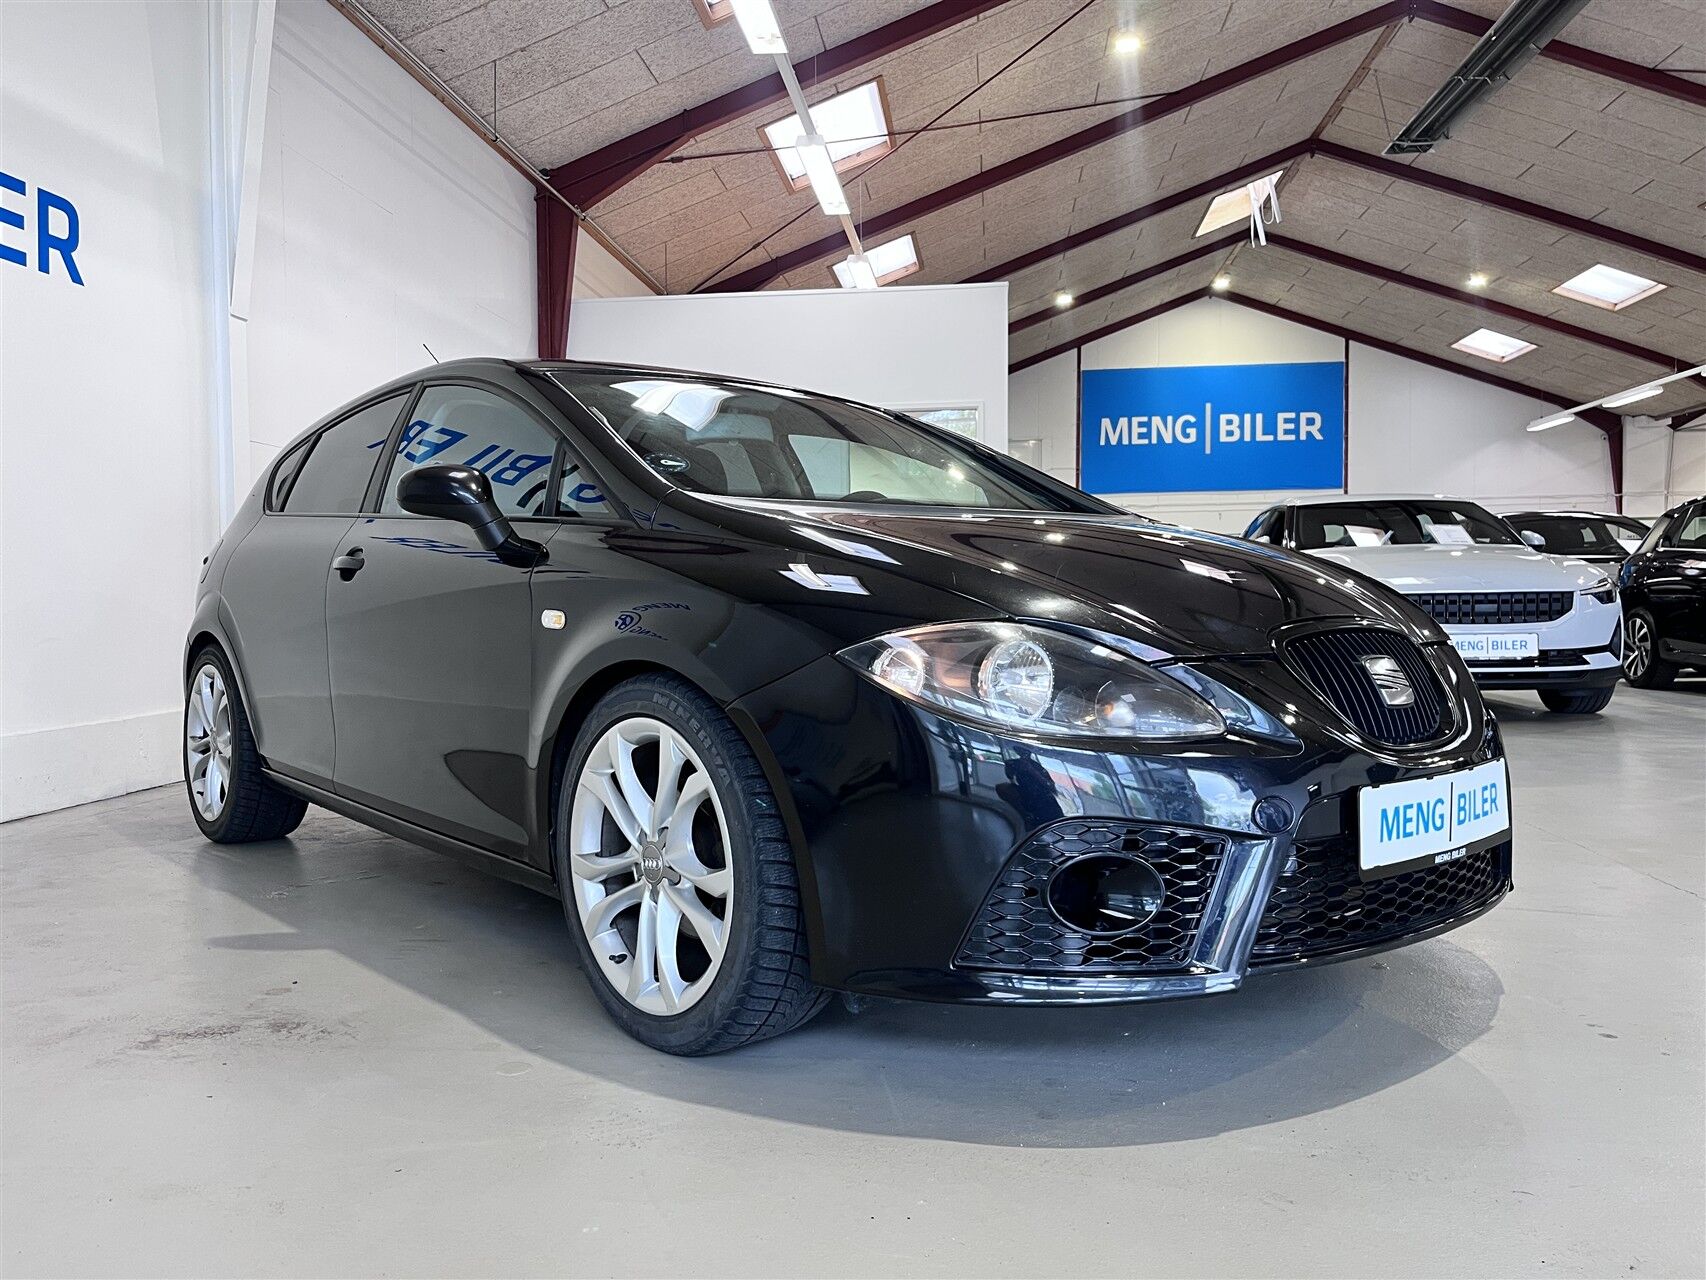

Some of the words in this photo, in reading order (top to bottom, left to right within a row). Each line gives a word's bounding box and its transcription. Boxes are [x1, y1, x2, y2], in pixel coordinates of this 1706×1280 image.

[1099, 414, 1197, 446] MENG
[1219, 411, 1324, 443] BILER
[1491, 639, 1528, 650] BILER
[652, 692, 732, 787] MINERVA
[1379, 797, 1445, 843] MENG
[1456, 782, 1499, 826] BILER
[1435, 851, 1451, 864] MENG
[1452, 847, 1467, 859] BILER
